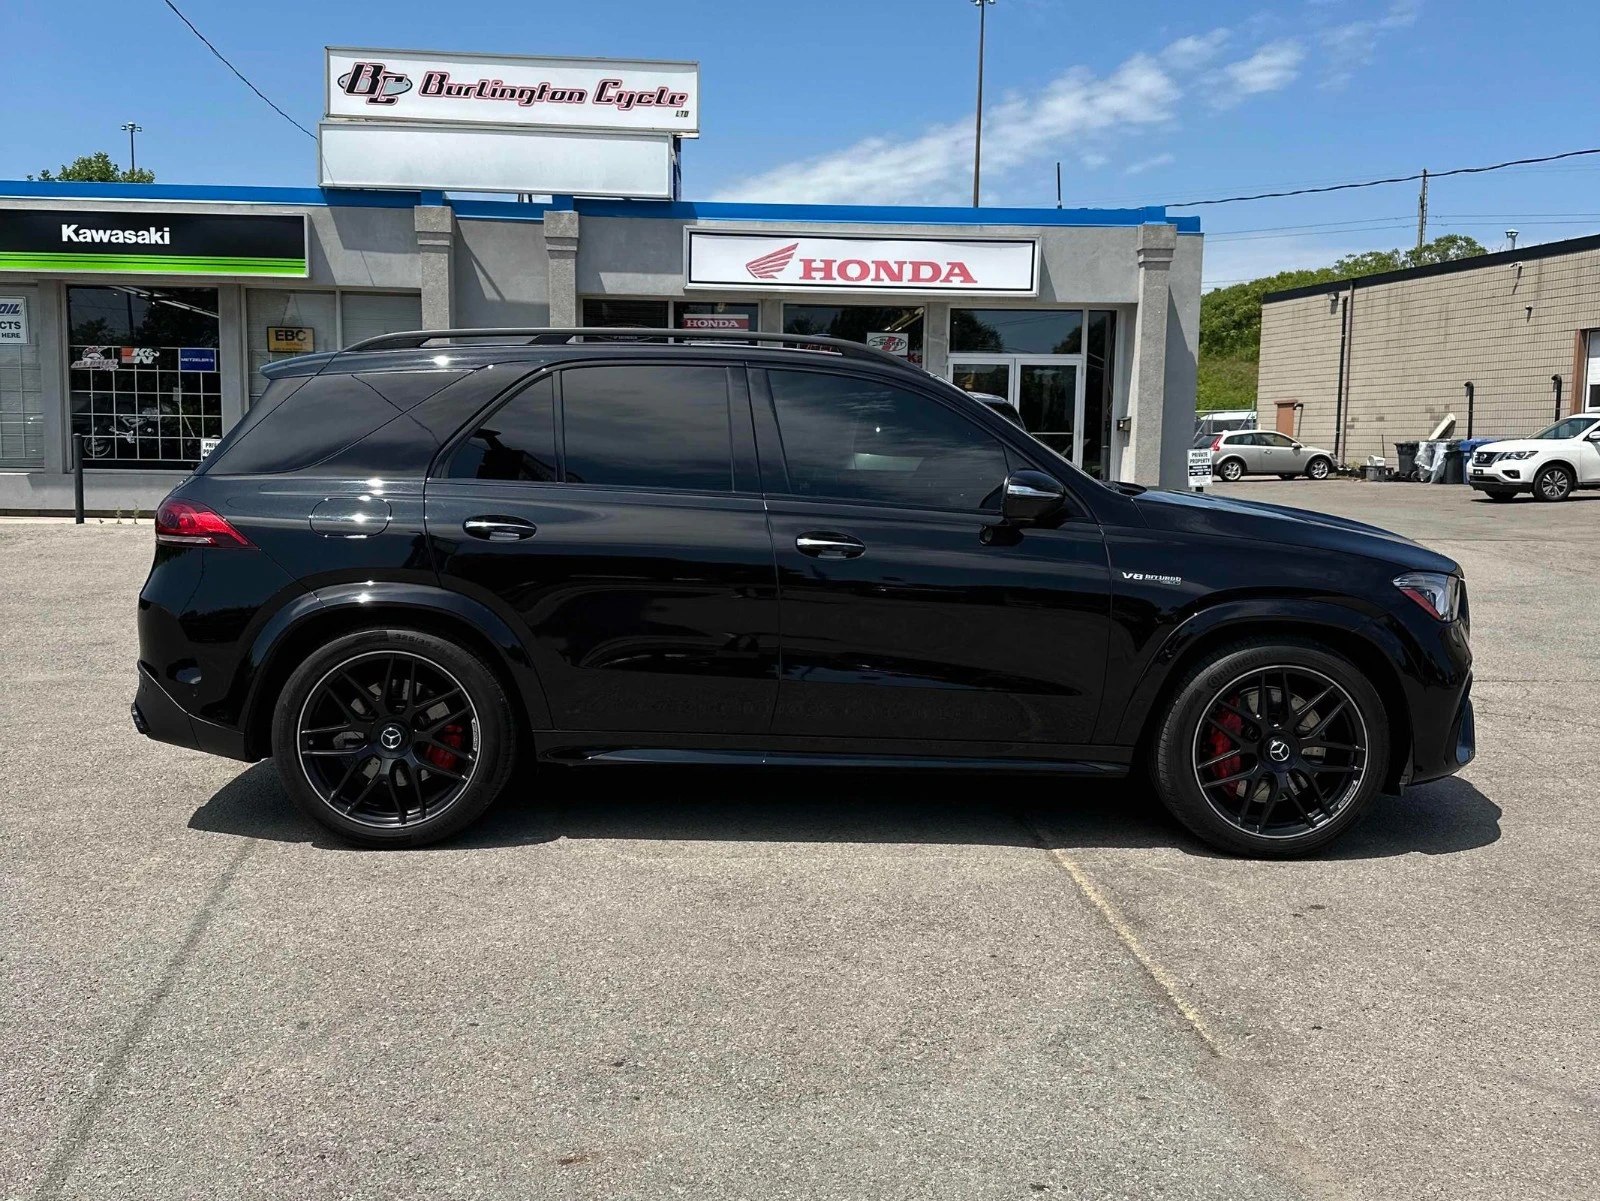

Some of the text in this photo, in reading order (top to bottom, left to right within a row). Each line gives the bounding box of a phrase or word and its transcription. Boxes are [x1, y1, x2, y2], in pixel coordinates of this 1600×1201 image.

[419, 71, 587, 107] Burlington
[592, 78, 689, 110] Cycle
[675, 110, 690, 118] LTD
[61, 224, 170, 245] Kawasaki
[799, 258, 978, 284] HONDA
[686, 319, 740, 328] HONDA
[275, 329, 306, 342] EBC
[1121, 571, 1144, 580] V8
